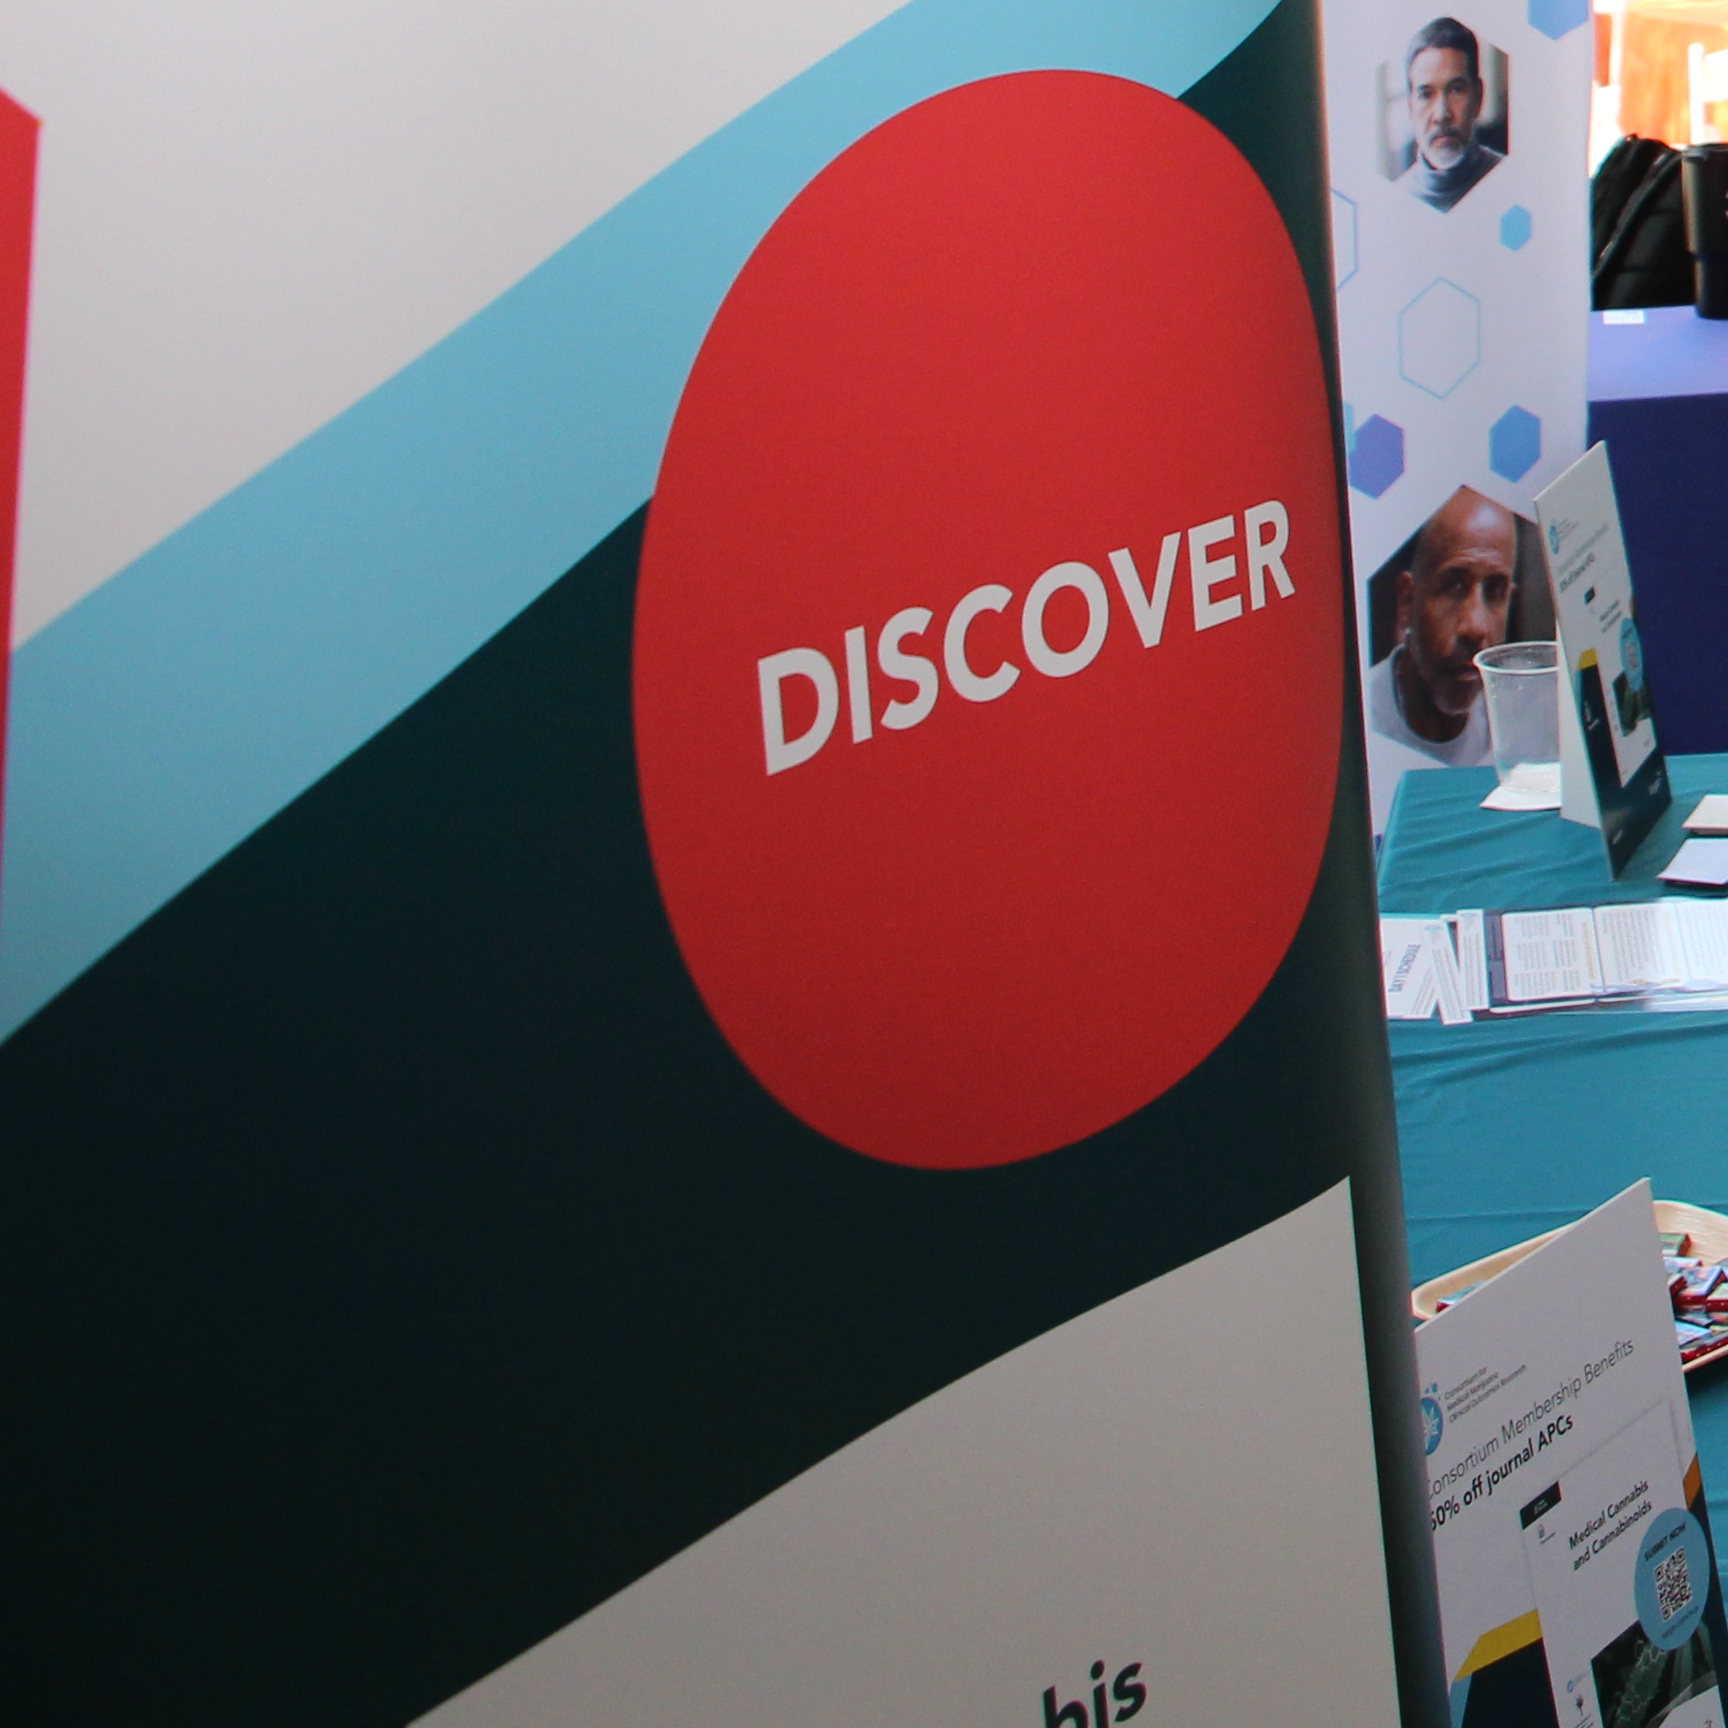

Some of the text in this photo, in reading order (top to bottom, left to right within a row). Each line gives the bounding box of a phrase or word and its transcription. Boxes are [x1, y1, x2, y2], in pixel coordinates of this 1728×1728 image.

[756, 499, 1296, 776] DISCOVER
[1501, 1378, 1582, 1444] Membership
[1582, 1338, 1635, 1384] Benefits
[1463, 1473, 1483, 1506] off
[1486, 1437, 1535, 1496] journal
[1537, 1414, 1574, 1453] APCs
[1569, 1480, 1649, 1549] Medical Cannabis
[1573, 1546, 1591, 1571] and
[1592, 1500, 1652, 1554] Cannabinoids
